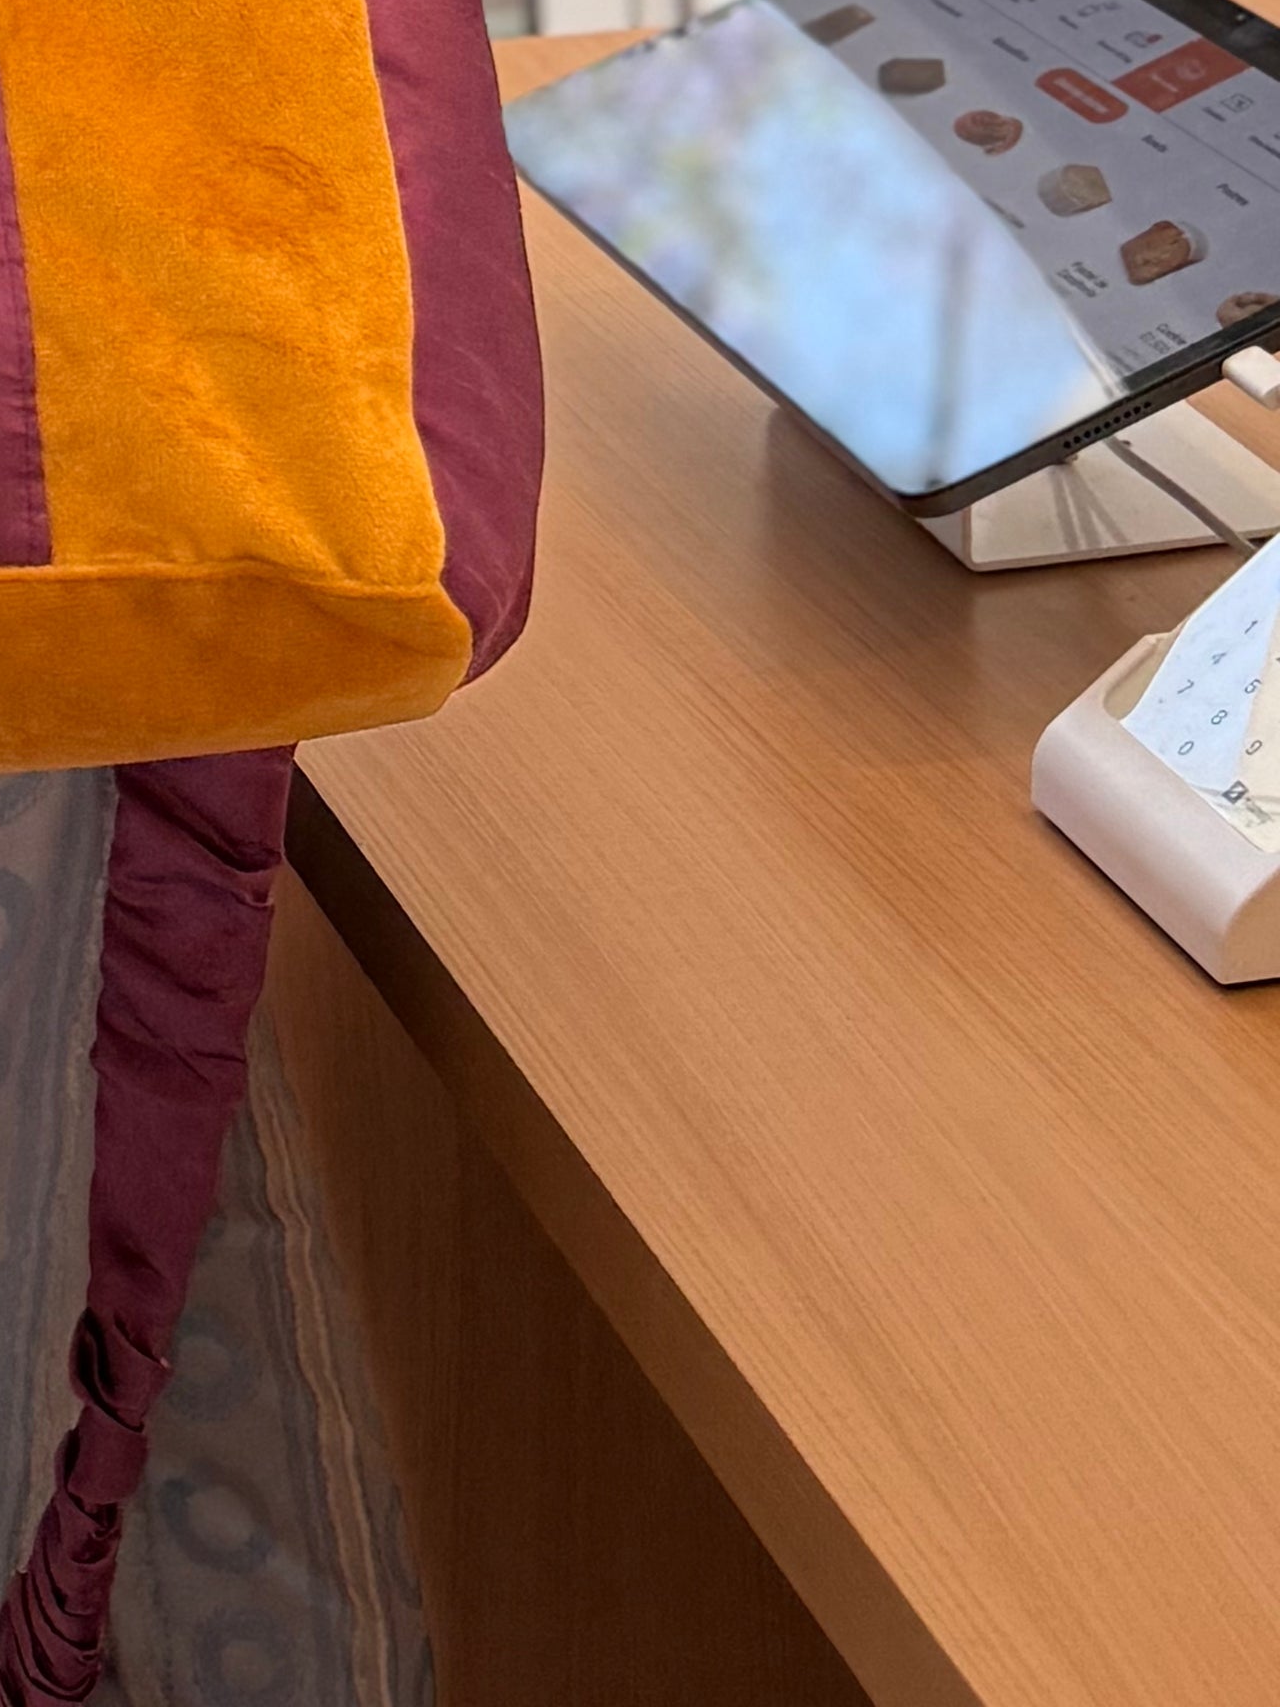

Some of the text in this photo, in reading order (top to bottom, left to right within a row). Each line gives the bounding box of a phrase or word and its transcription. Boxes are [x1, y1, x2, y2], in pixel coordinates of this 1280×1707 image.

[1244, 620, 1258, 634] 1
[1212, 652, 1227, 665] 4
[1177, 679, 1262, 756] 7 8 9
[1178, 741, 1195, 756] 0
